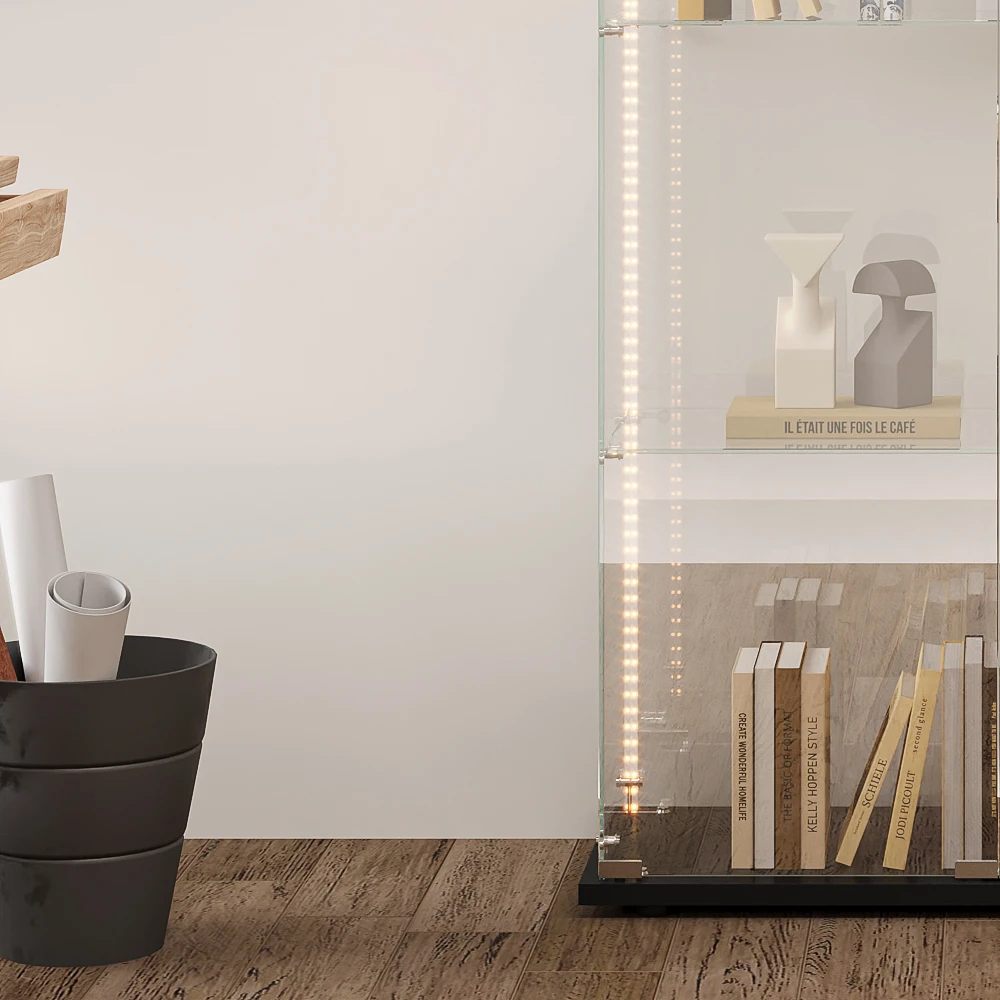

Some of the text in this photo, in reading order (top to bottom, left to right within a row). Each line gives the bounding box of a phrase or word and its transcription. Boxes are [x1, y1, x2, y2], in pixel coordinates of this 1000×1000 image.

[784, 418, 916, 434] IL ÉTAIT UNE FOIS LE CAFÉ
[738, 712, 747, 821] CREATE WONDERFUL HOMELIFE
[783, 711, 793, 823] THE BASIC OF FORMAT
[807, 716, 818, 833] KELLY HOPPEN STYLE
[861, 758, 888, 809] SCHIELE
[895, 698, 928, 841] JODI PICOULT second glance
